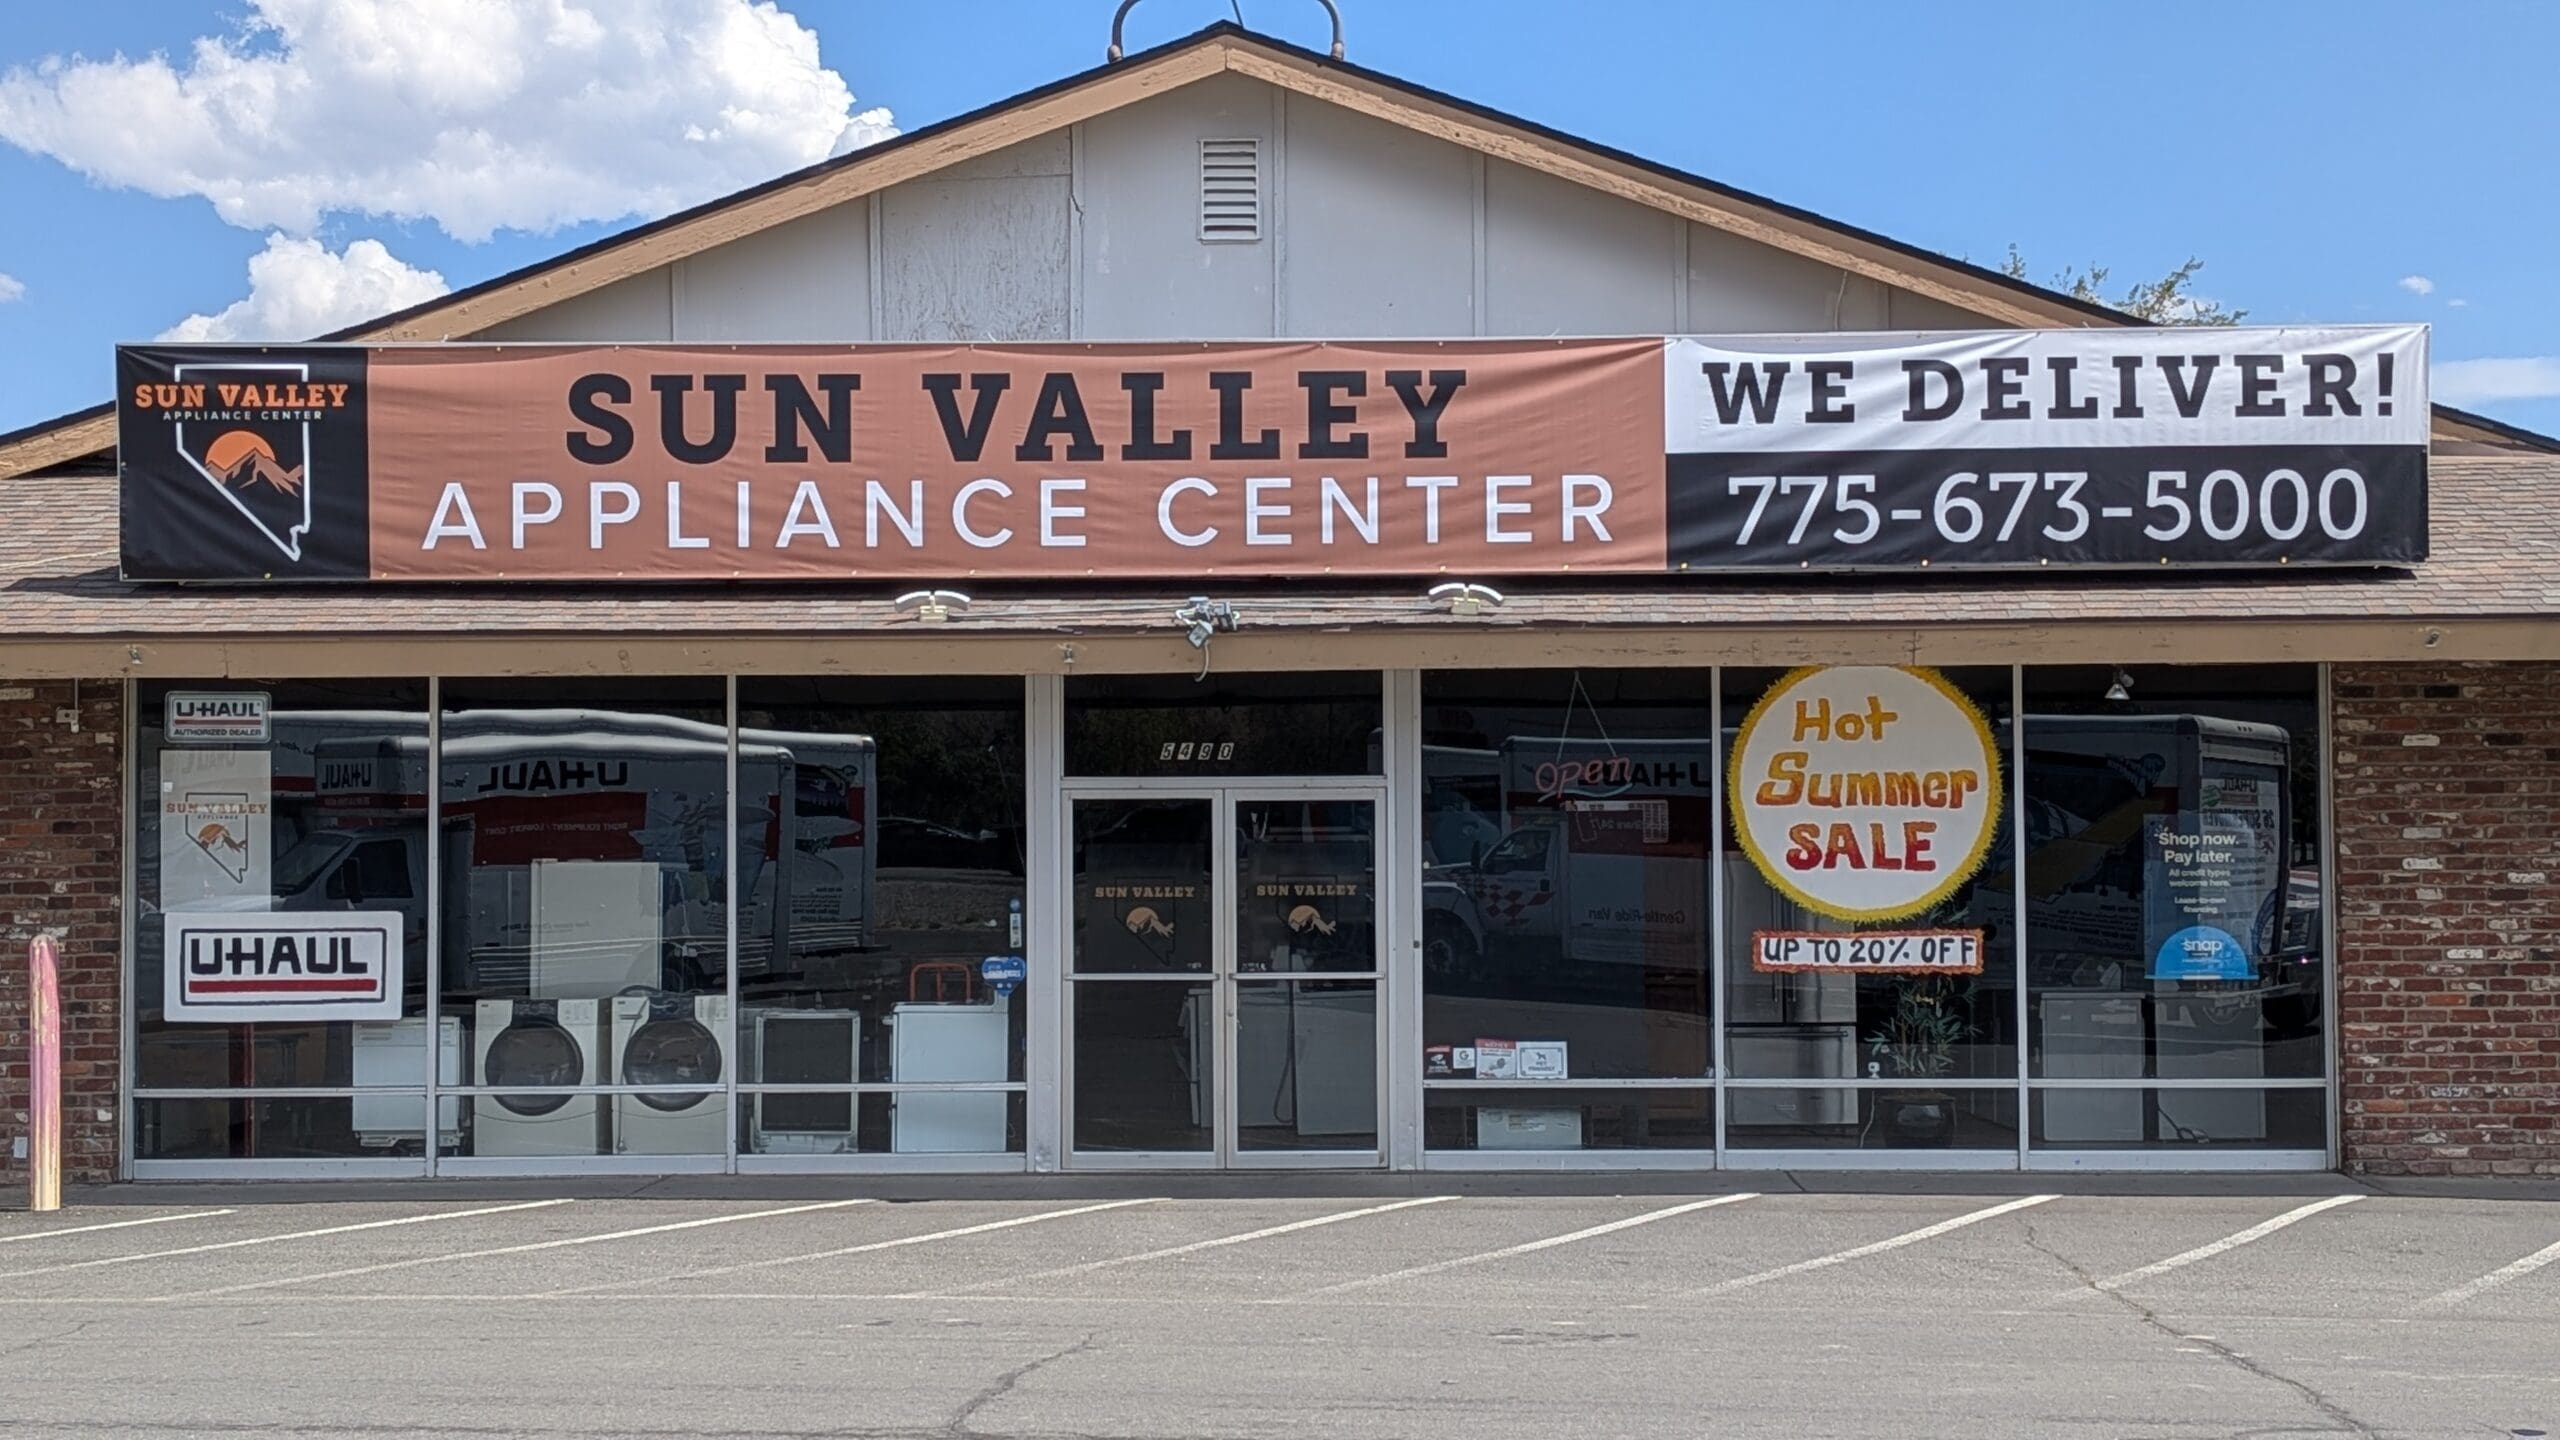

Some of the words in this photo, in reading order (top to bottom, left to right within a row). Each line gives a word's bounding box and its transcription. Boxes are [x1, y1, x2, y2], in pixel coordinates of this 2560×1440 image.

[136, 384, 205, 408] SUN
[218, 384, 348, 408] VALLEY
[1702, 361, 1856, 425] WE
[1901, 352, 2395, 422] DELIVER!
[163, 411, 251, 420] APPLIANCE
[261, 410, 322, 420] CENTER
[566, 373, 861, 465] SUN
[922, 369, 1467, 462] VALLEY
[421, 478, 1087, 550] APPLIANCE
[1157, 474, 1614, 547] CENTER
[1728, 468, 2368, 546] 775-673-5000
[1792, 695, 1898, 742] Hot
[1160, 742, 1235, 760] 5490
[1755, 751, 1978, 809] Summer
[1786, 821, 1937, 871] SALE
[2158, 832, 2200, 849] Shop
[2202, 834, 2240, 846] now.
[2164, 850, 2193, 865] Pay
[2196, 850, 2235, 863] later.
[2168, 879, 2208, 887] welcome
[2181, 869, 2205, 877] credit
[1095, 886, 1126, 898] SUN
[1132, 886, 1195, 898] VALLEY
[1256, 885, 1290, 896] SUN
[1295, 885, 1357, 896] VALLEY
[1763, 938, 1800, 962] UP
[1808, 939, 1841, 963] TO
[1849, 938, 1910, 964] 20%
[1921, 937, 1976, 964] OFF
[2183, 939, 2222, 955] snap
